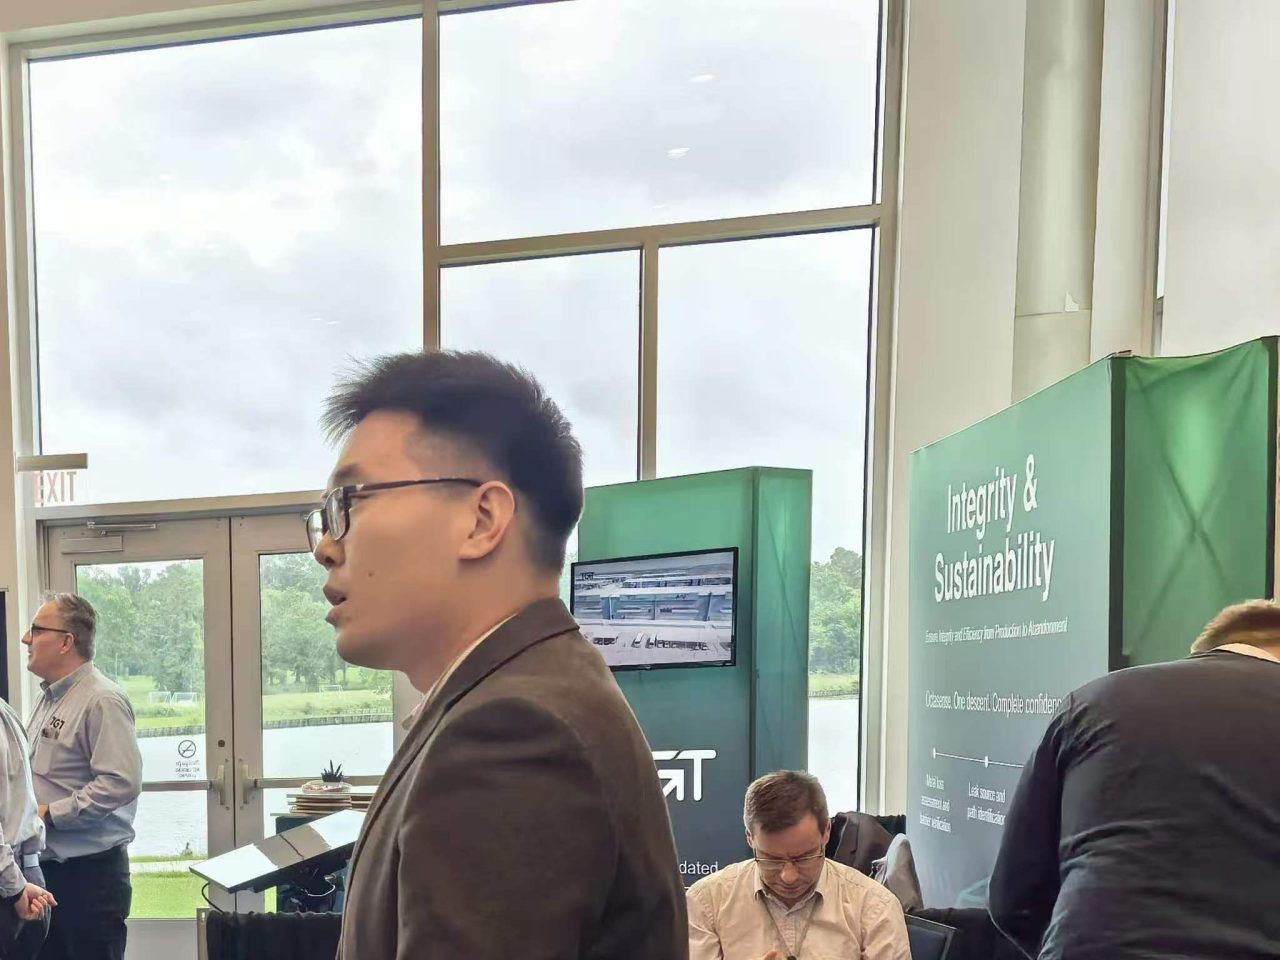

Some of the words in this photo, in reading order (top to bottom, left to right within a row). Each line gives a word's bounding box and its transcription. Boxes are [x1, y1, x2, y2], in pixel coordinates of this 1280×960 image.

[31, 471, 77, 502] EXIT
[946, 466, 1017, 540] Integrity
[1023, 453, 1038, 512] &
[934, 530, 1055, 603] Sustainability
[983, 625, 994, 640] from
[995, 623, 1021, 639] Production
[1028, 616, 1068, 637] Abandonment
[954, 691, 965, 710] One
[992, 692, 1024, 718] Complete
[968, 781, 979, 798] Leak
[979, 788, 996, 801] source
[996, 788, 1006, 803] and
[680, 861, 718, 874] dated
